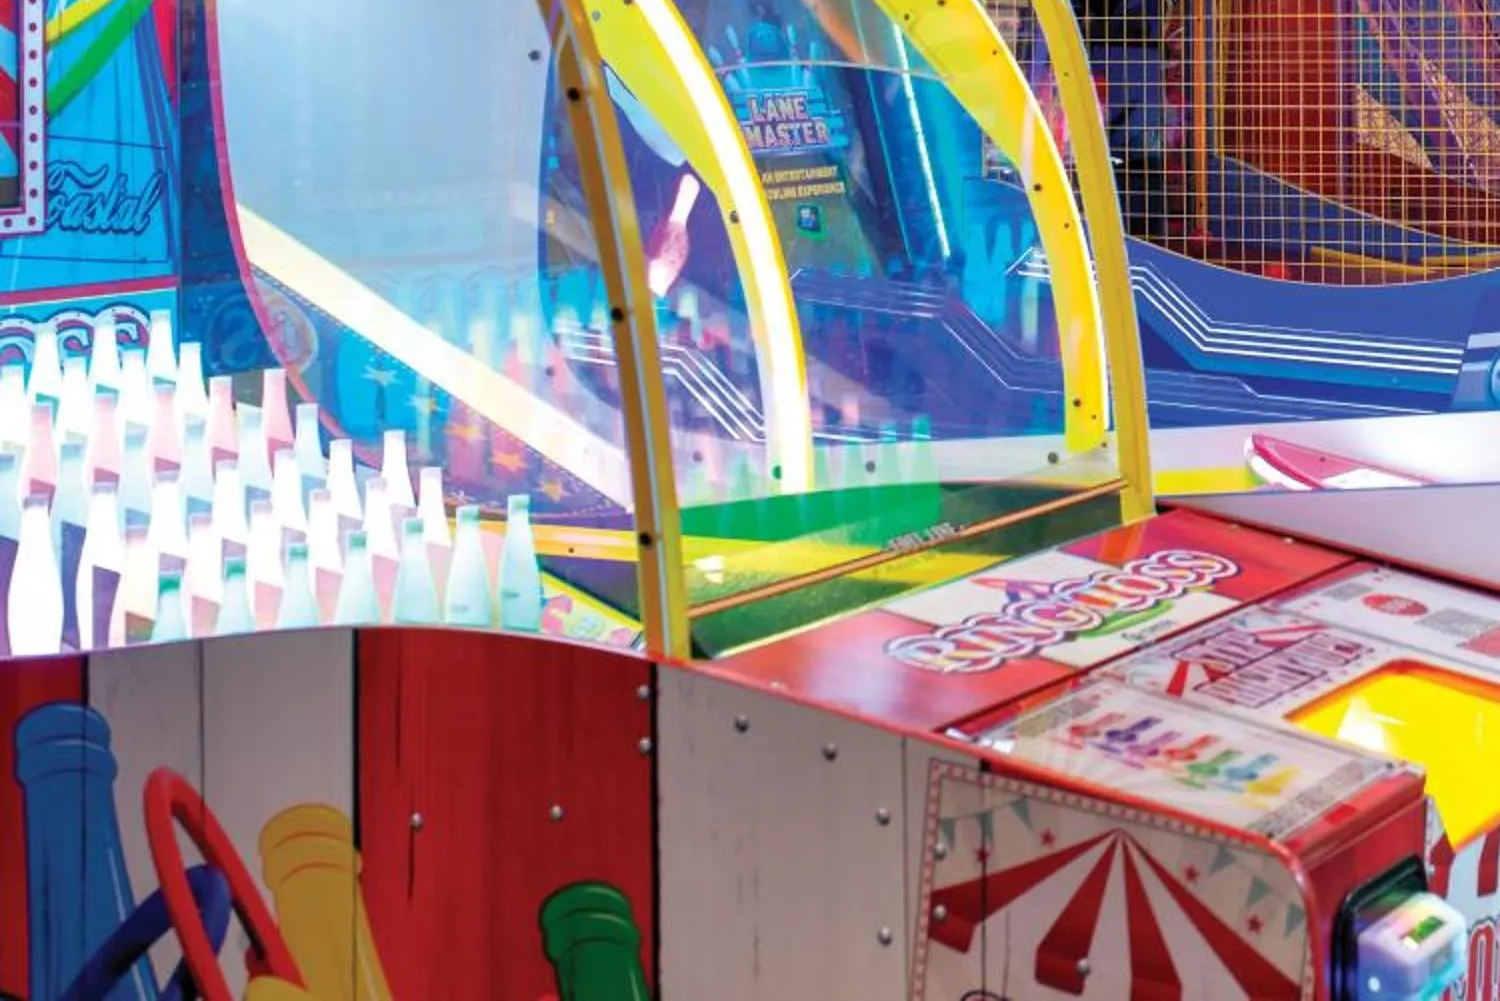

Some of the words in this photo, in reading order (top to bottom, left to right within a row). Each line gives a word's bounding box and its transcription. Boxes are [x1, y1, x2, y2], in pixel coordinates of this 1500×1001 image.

[747, 93, 809, 123] LANE
[743, 118, 829, 148] MASTER
[886, 603, 1104, 672] RING
[1052, 551, 1227, 611] TOSS
